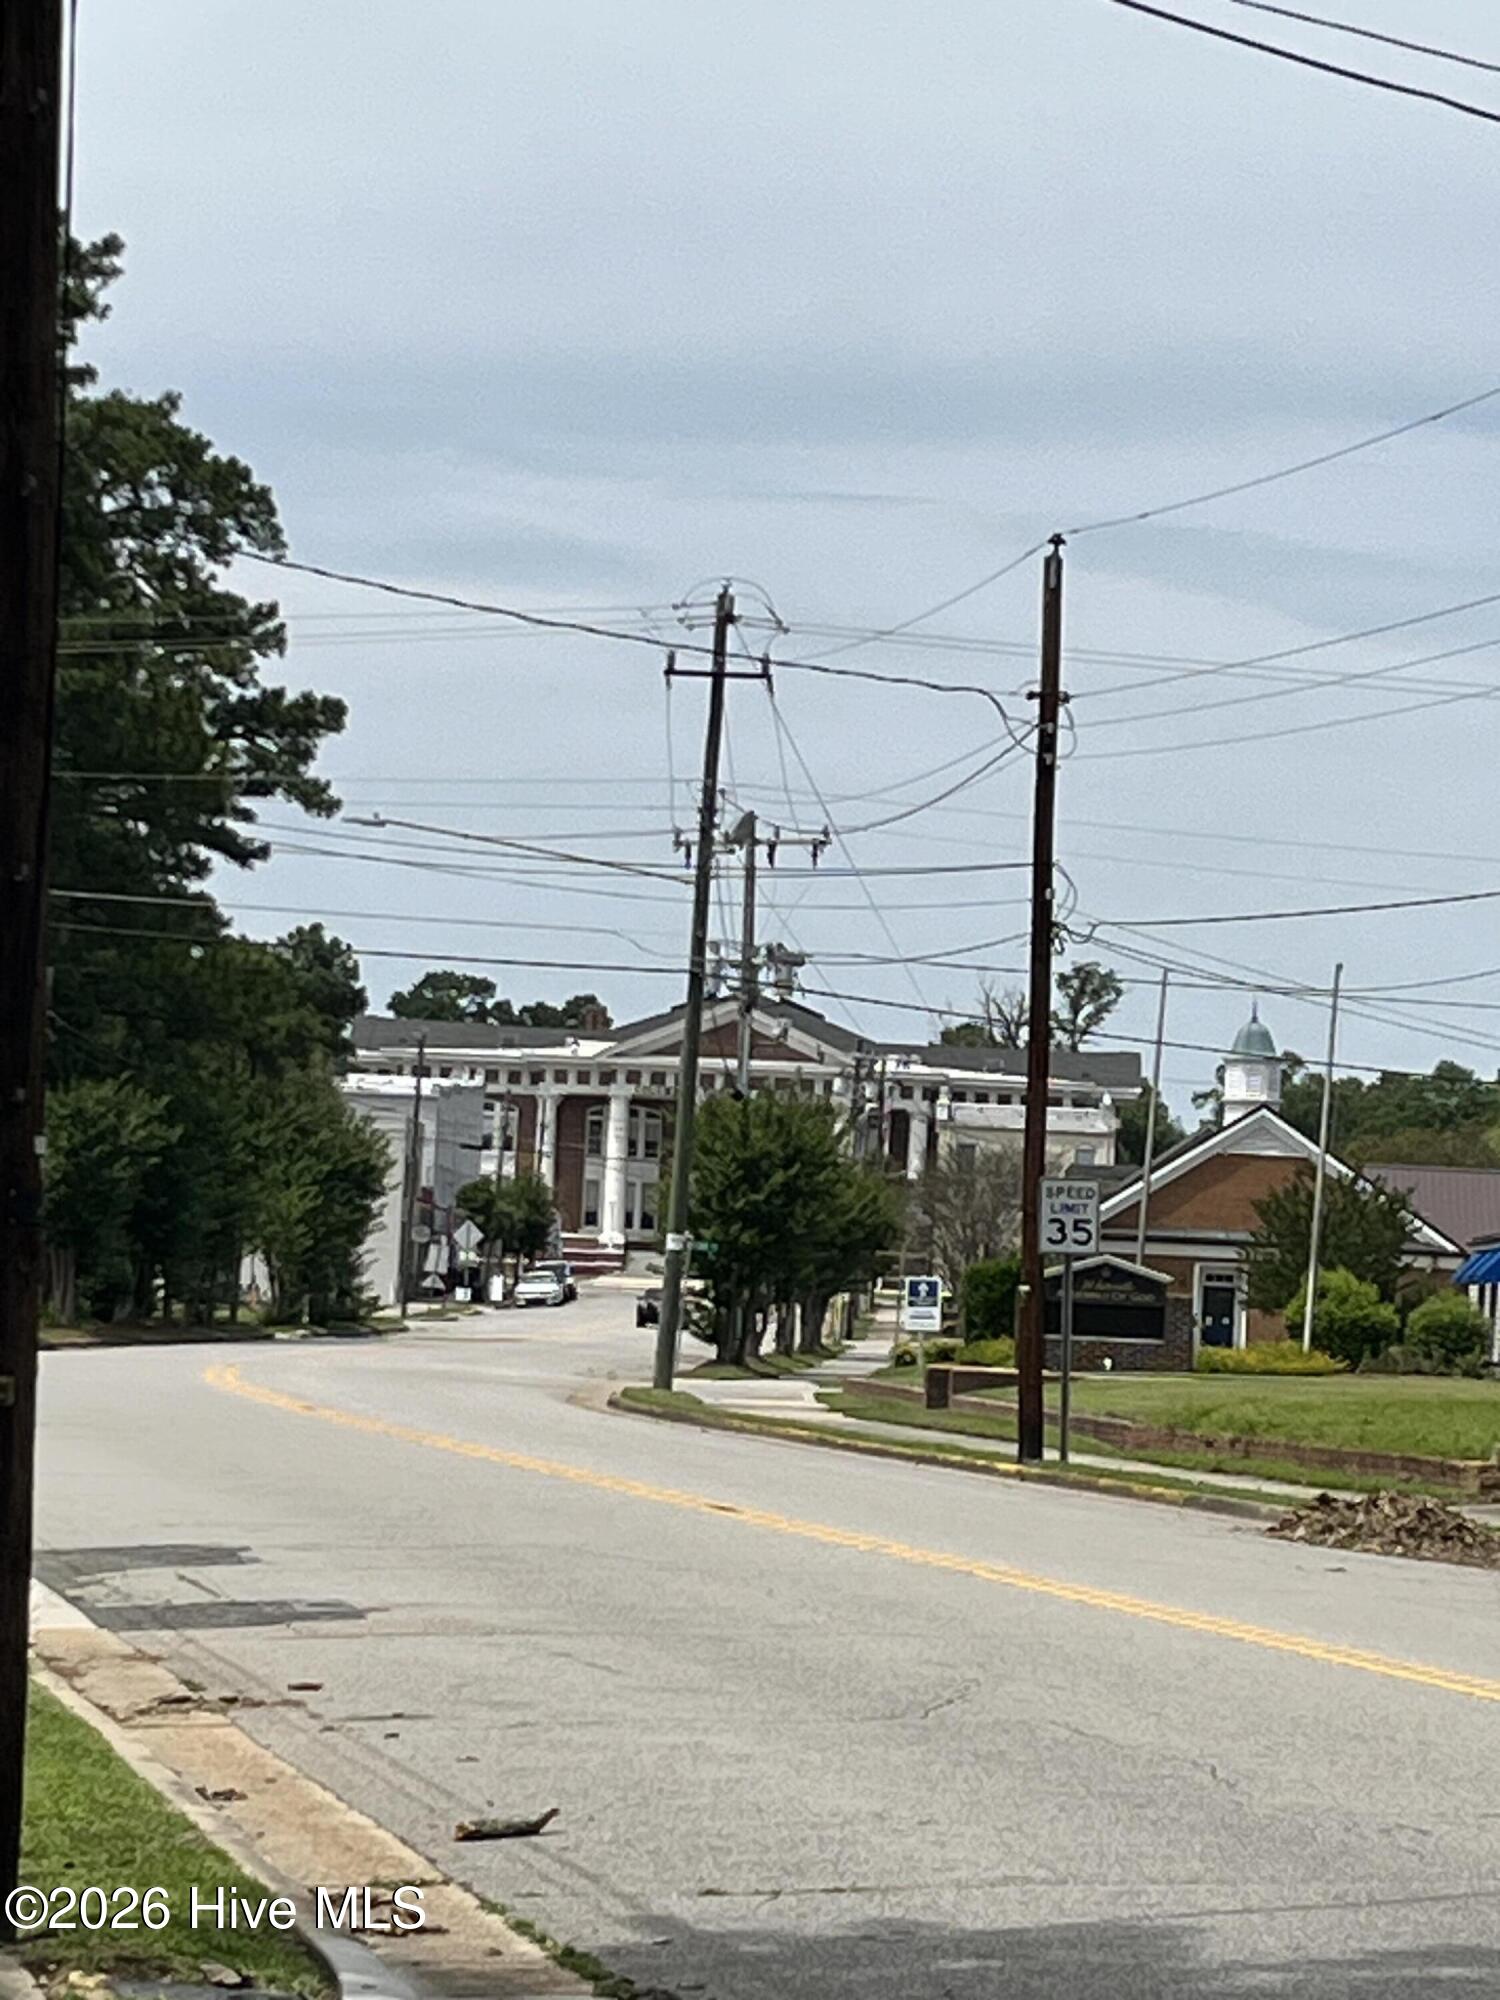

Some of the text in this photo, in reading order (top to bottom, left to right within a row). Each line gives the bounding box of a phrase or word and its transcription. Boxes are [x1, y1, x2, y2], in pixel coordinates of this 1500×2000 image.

[1045, 1186, 1096, 1199] SPEED
[1050, 1203, 1088, 1215] LIMIT
[1046, 1217, 1093, 1246] 35
